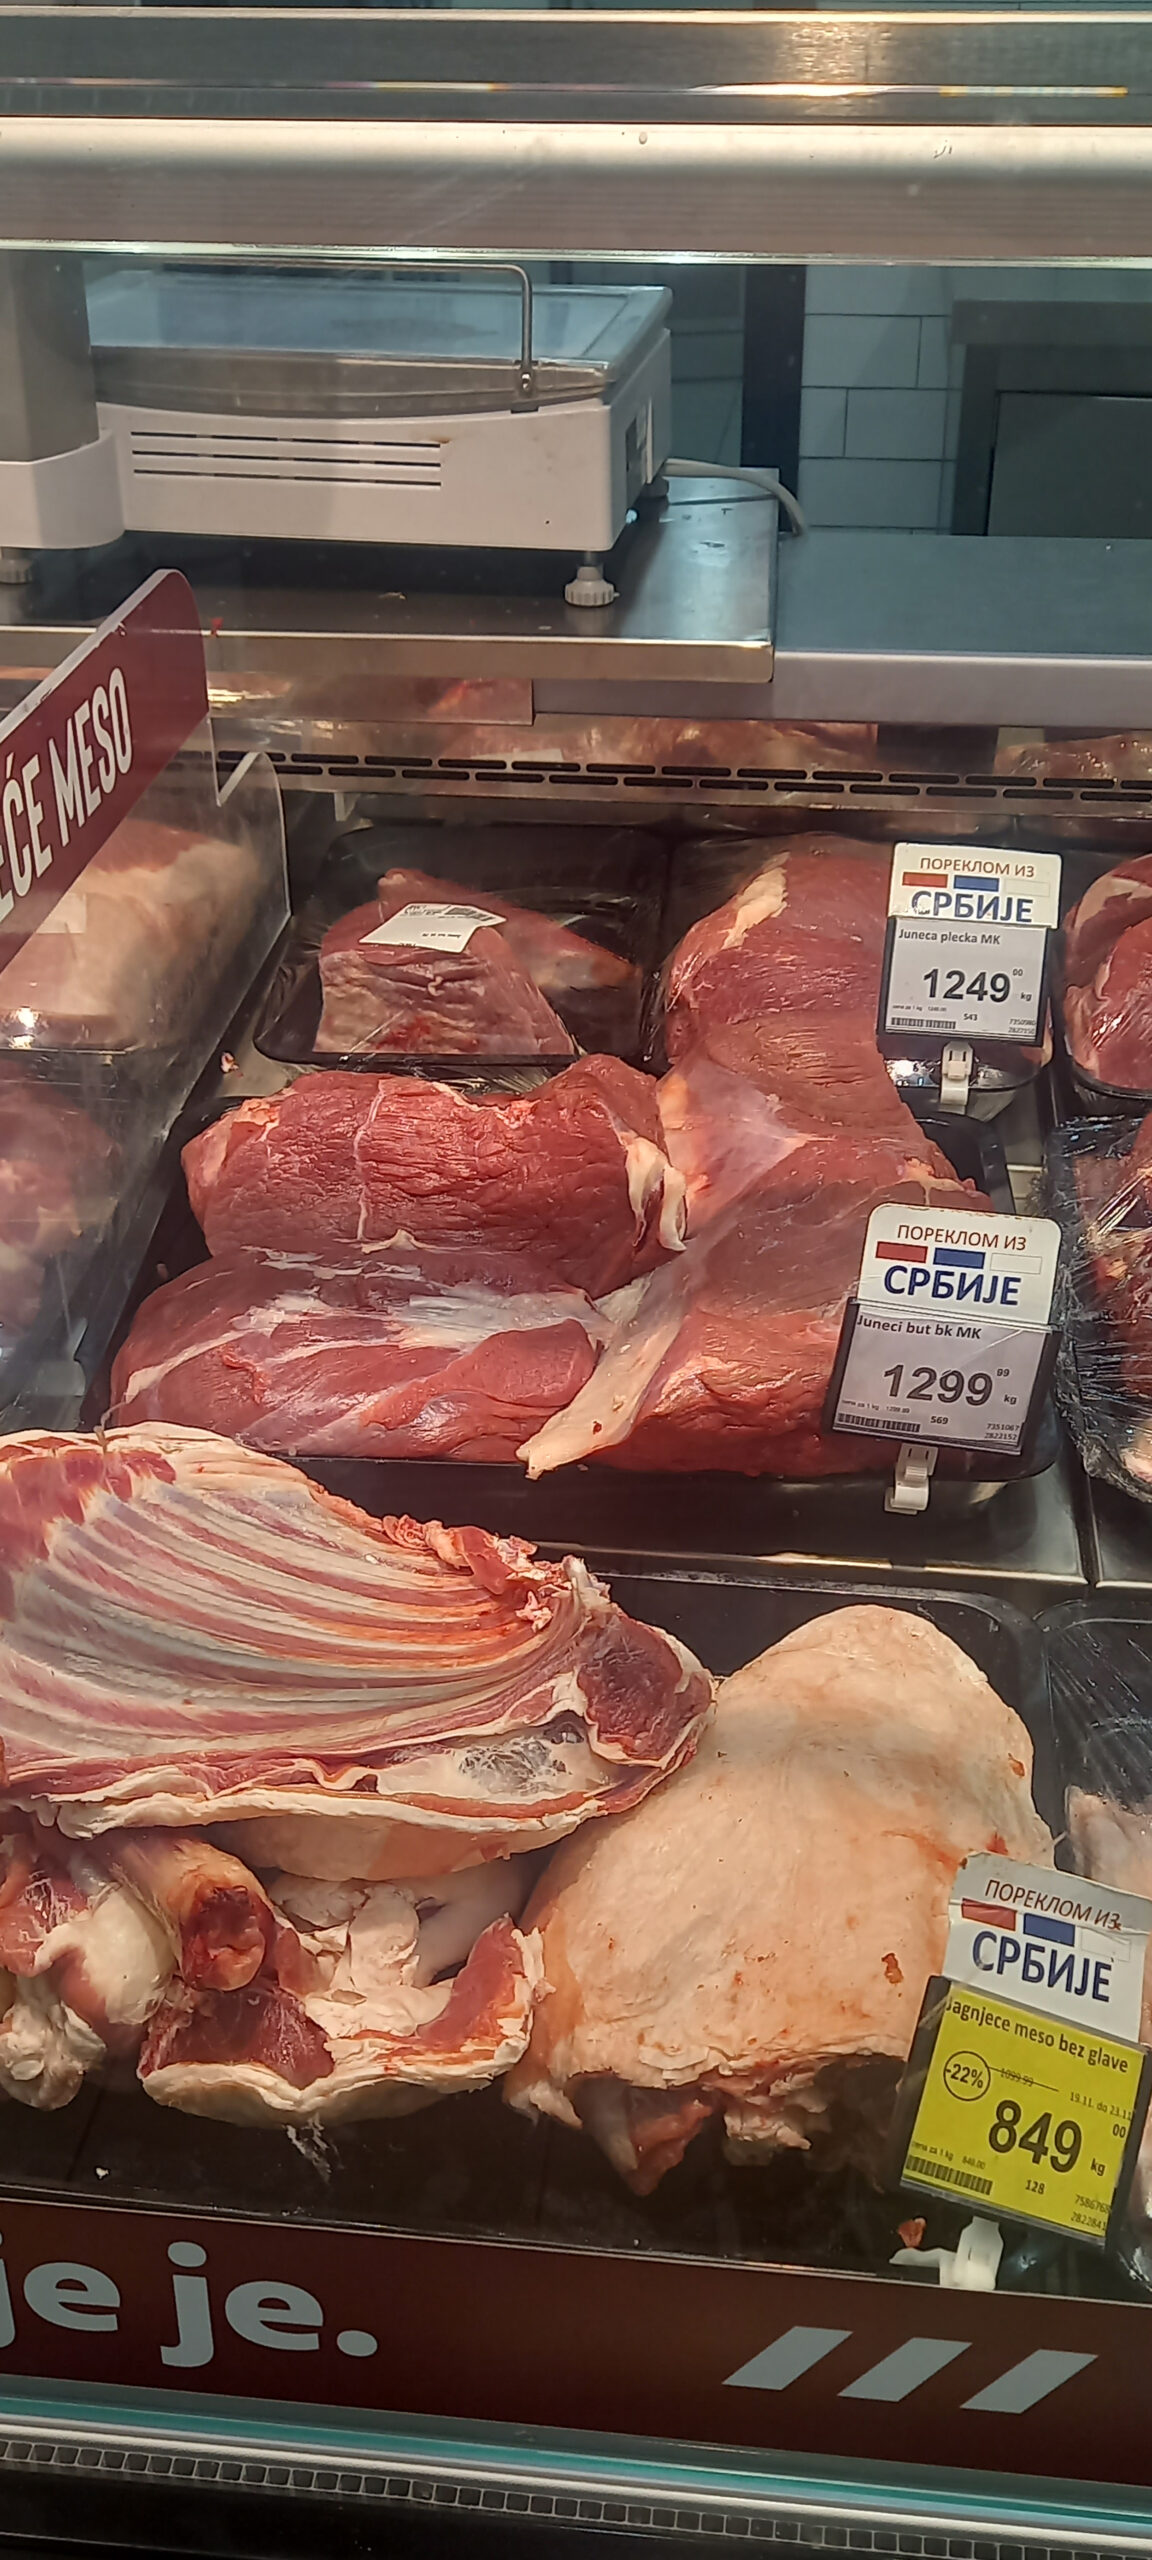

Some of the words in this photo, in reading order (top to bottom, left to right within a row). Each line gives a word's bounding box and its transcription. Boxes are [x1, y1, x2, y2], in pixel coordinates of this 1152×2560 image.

[48, 667, 133, 847] MESO
[920, 857, 1010, 875] ПОРЕКЛОМ
[1015, 866, 1035, 878] ИЗ
[911, 890, 1034, 923] СРБИЈЕ
[899, 929, 937, 940] Juneca
[940, 932, 978, 943] plecka
[980, 934, 1000, 945] MK
[923, 968, 1011, 1003] 1249
[1021, 992, 1032, 1002] kg
[897, 1224, 999, 1249] ПОРЕКЛОМ
[1003, 1235, 1027, 1250] ИЗ
[884, 1265, 1022, 1306] СРБИЈЕ
[857, 1315, 903, 1332] Juneci
[906, 1322, 931, 1335] but
[935, 1324, 953, 1337] bk
[956, 1326, 982, 1339] MK
[884, 1364, 993, 1406] 1299
[1004, 1394, 1017, 1405] kg
[930, 1416, 949, 1424] 569
[985, 1880, 1092, 1923] ПОРЕКЛОМ
[1094, 1906, 1119, 1930] ИЗ
[972, 1930, 1112, 2003] СРБИЈЕ
[1014, 2022, 1055, 2048] meso
[1058, 2034, 1085, 2058] bez
[1087, 2047, 1129, 2073] glave
[945, 2063, 984, 2089] -22%
[988, 2099, 1082, 2173] 849
[1112, 2123, 1126, 2138] 00
[1090, 2158, 1106, 2176] kg
[1025, 2179, 1046, 2195] 128
[160, 2241, 378, 2368] je.
